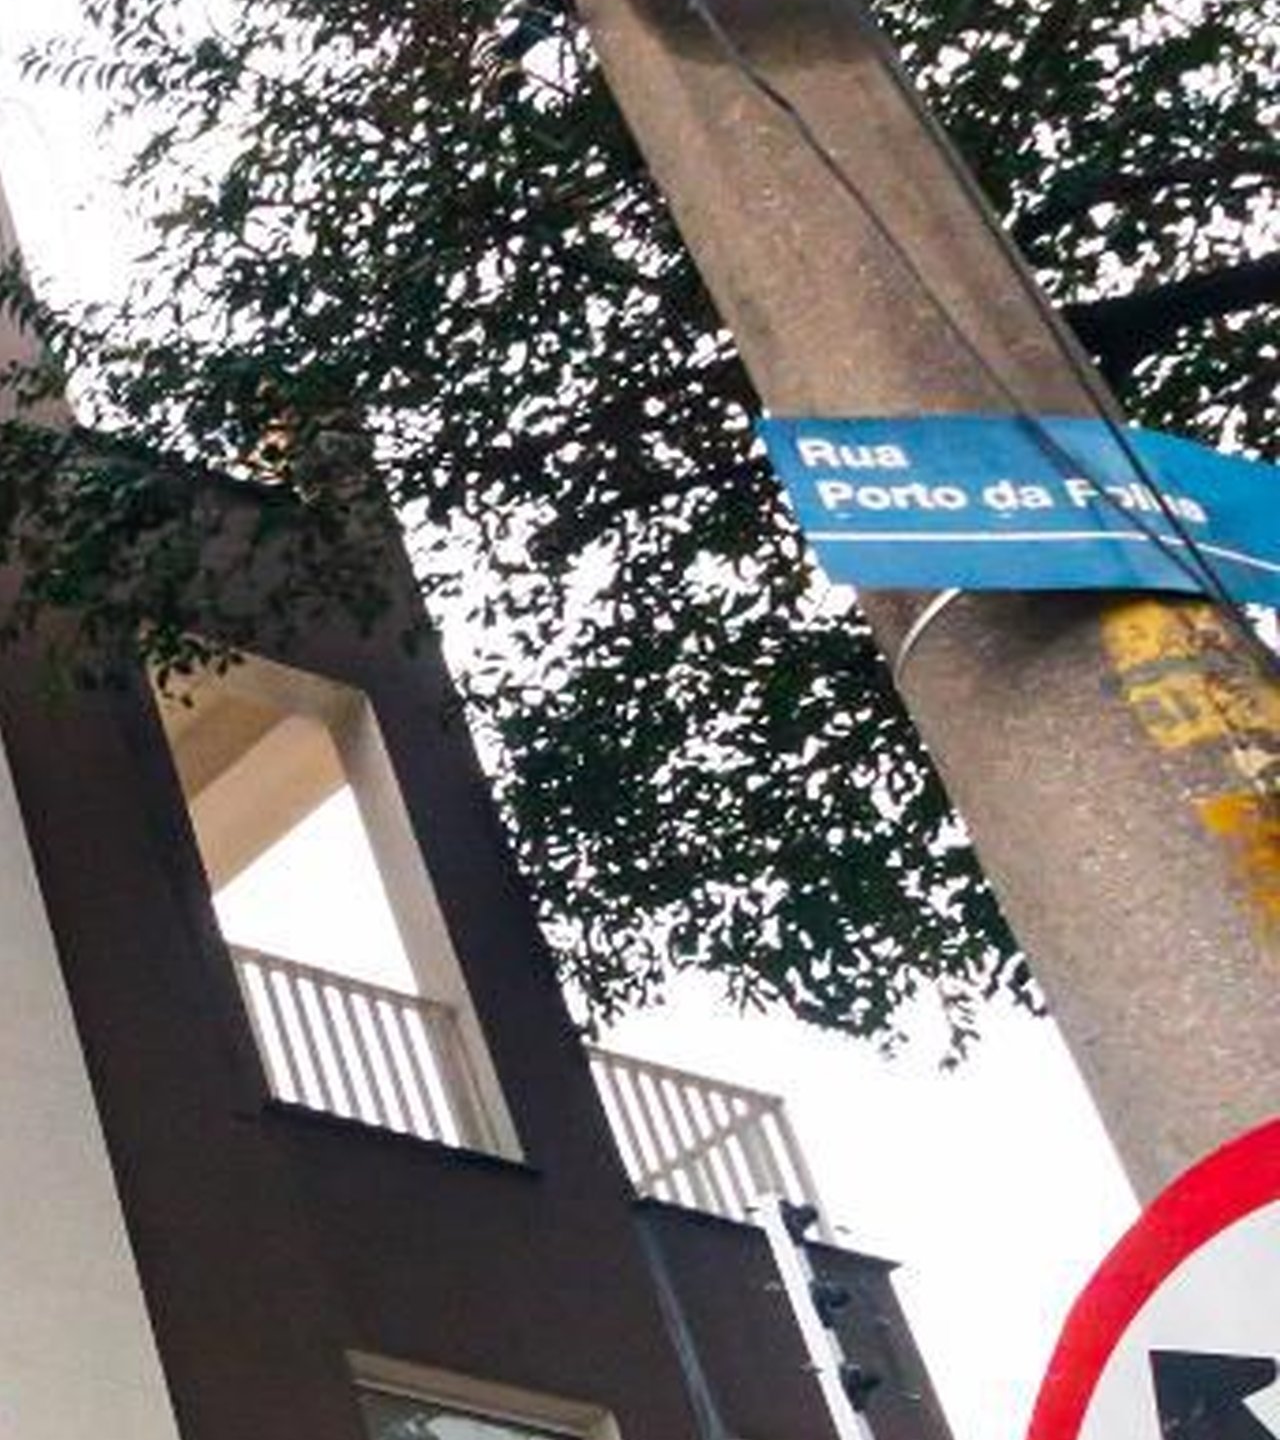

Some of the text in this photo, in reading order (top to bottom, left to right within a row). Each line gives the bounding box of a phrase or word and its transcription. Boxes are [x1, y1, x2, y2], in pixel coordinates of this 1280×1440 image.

[796, 437, 910, 469] Rua
[815, 480, 969, 510] Porto
[981, 478, 1055, 510] da
